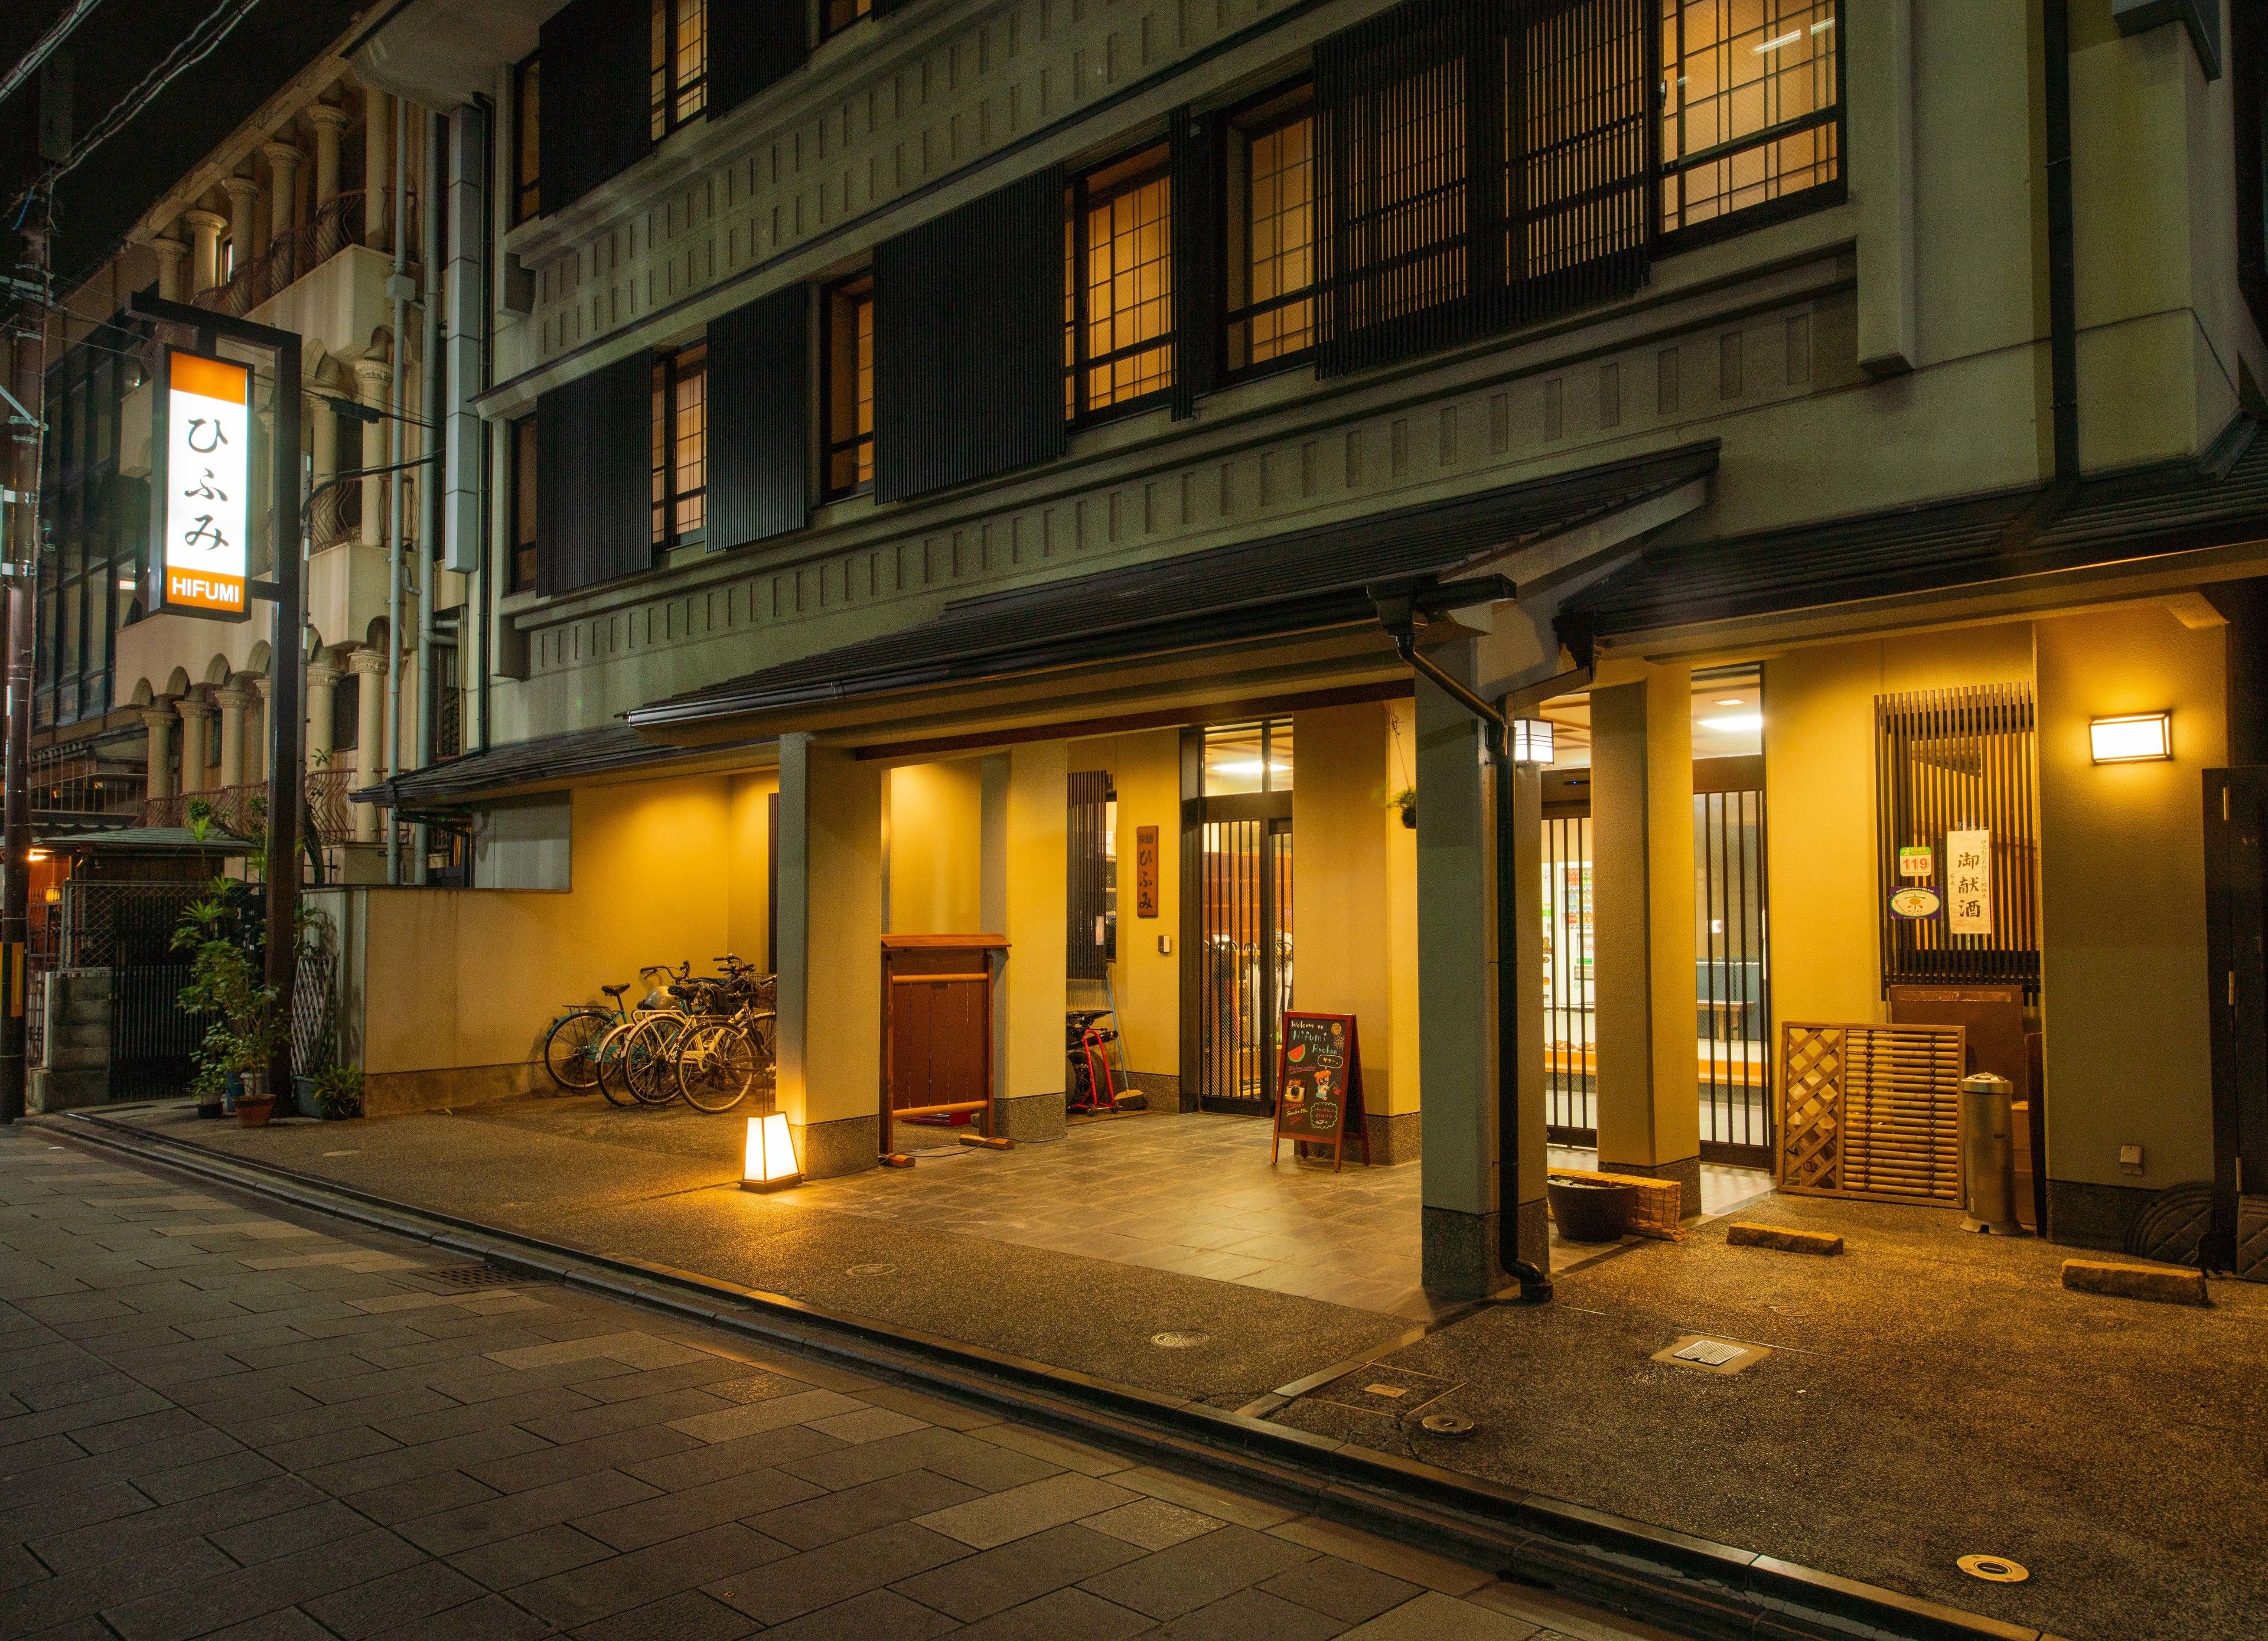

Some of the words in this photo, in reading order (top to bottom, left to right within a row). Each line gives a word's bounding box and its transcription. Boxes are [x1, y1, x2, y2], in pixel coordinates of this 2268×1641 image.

[184, 418, 229, 550] ひふみ
[171, 576, 239, 603] HIFUMI
[1139, 850, 1153, 908] ひふみ
[1903, 858, 1928, 869] 119
[1957, 852, 1980, 918] 御献酒
[1293, 1029, 1327, 1042] Hifumi
